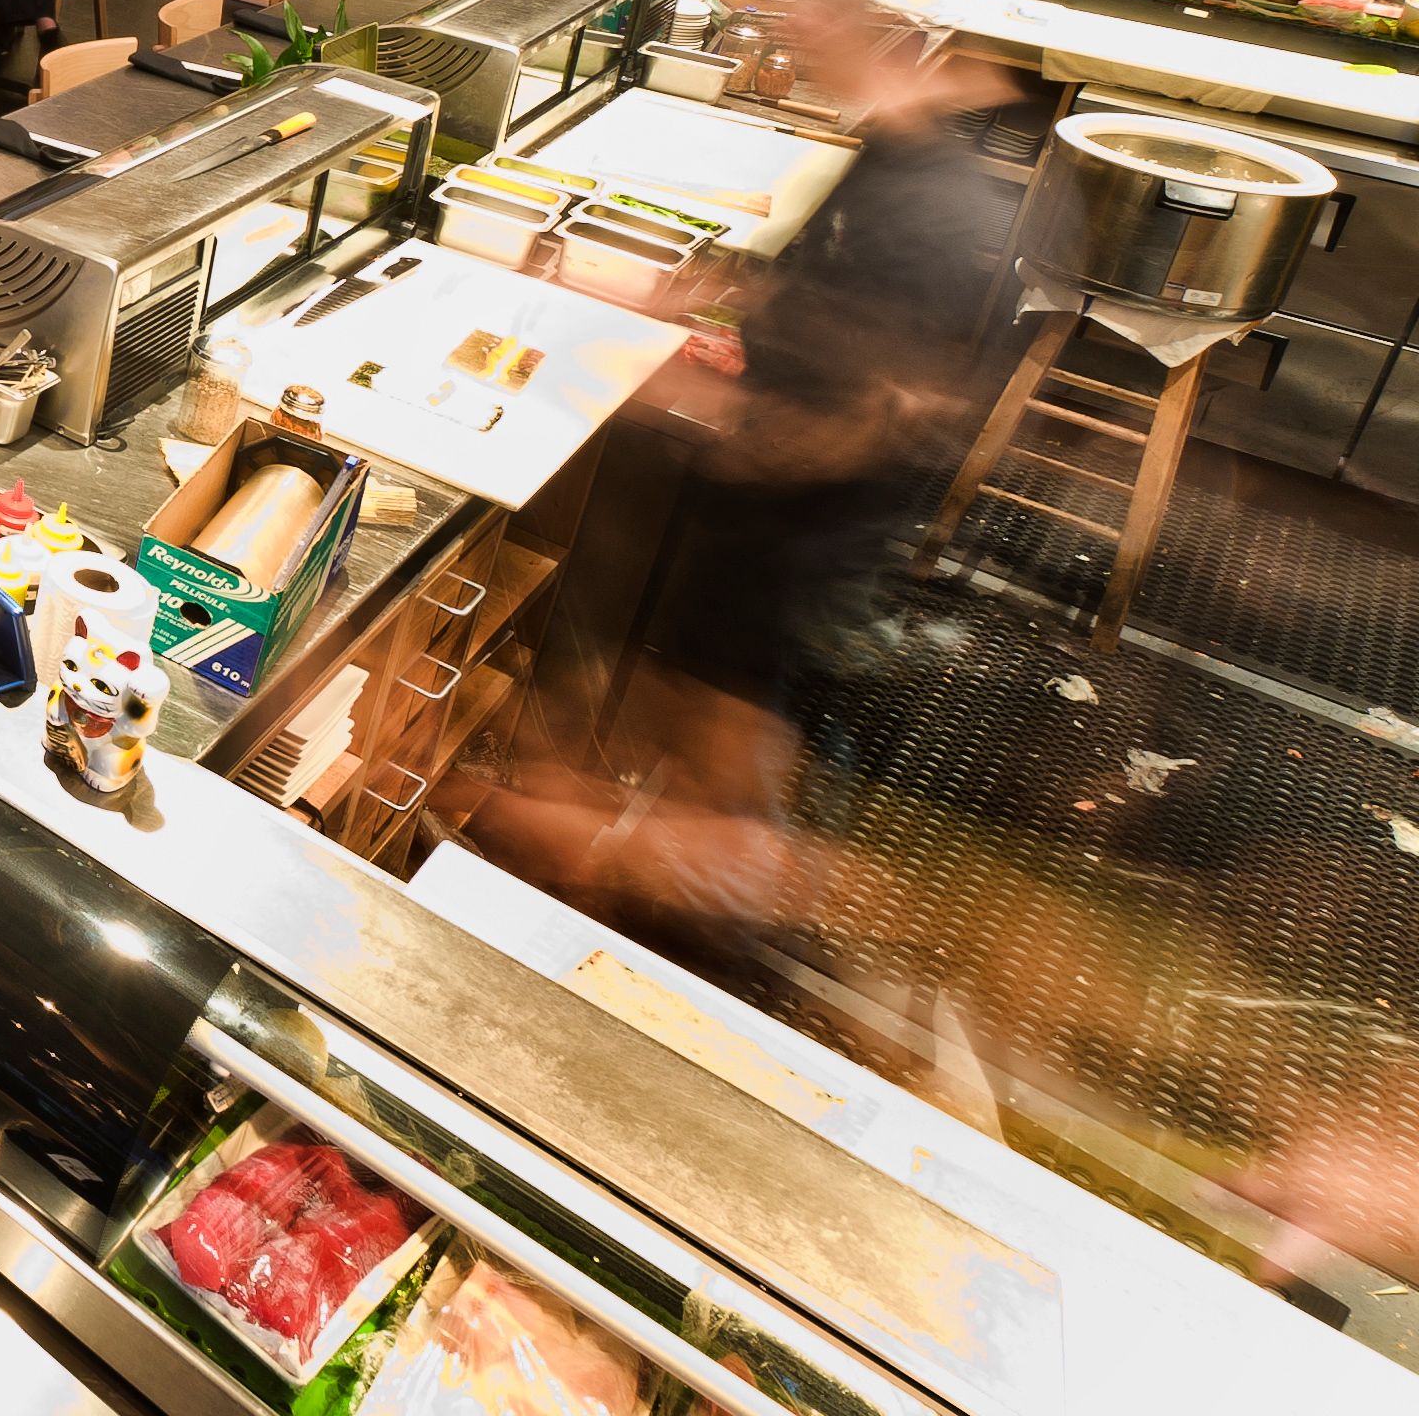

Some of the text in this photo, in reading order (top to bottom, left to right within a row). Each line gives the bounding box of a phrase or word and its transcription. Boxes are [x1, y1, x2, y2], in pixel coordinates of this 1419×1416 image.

[147, 545, 234, 593] Reynolds
[159, 592, 184, 609] 10
[169, 579, 228, 611] PELLICULE
[211, 661, 241, 682] 610
